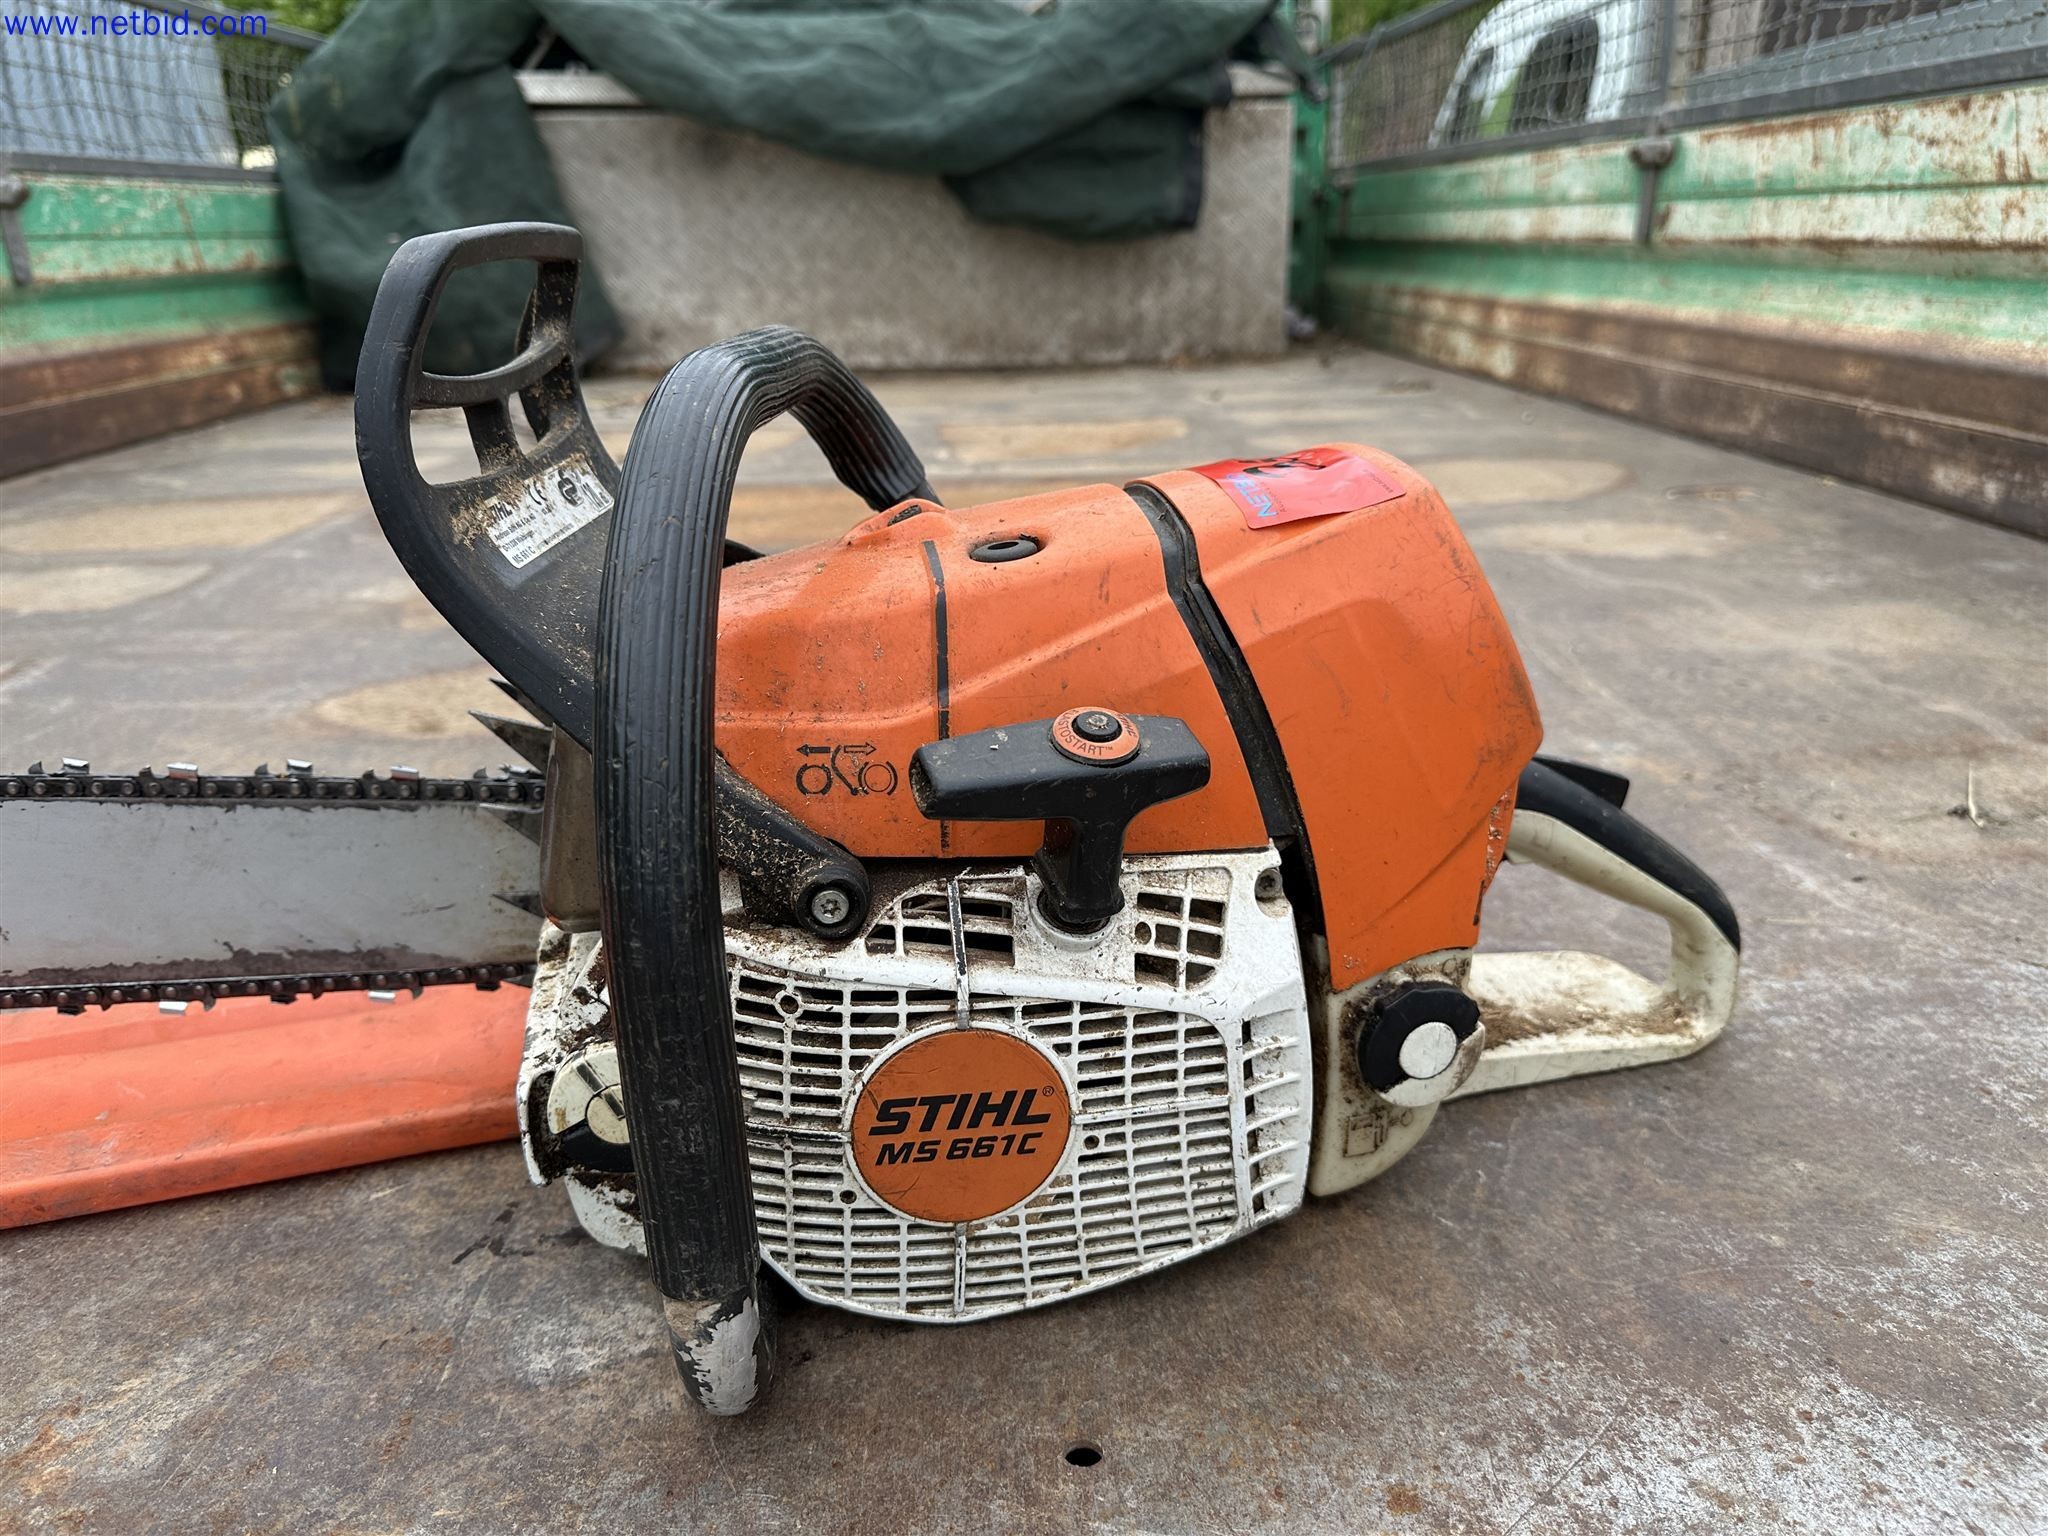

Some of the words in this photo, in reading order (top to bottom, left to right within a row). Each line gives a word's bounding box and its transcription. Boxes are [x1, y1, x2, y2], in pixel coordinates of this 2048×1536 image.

[868, 1088, 1052, 1136] STIHL
[875, 1139, 942, 1166] MS
[946, 1131, 1044, 1161] 661C
